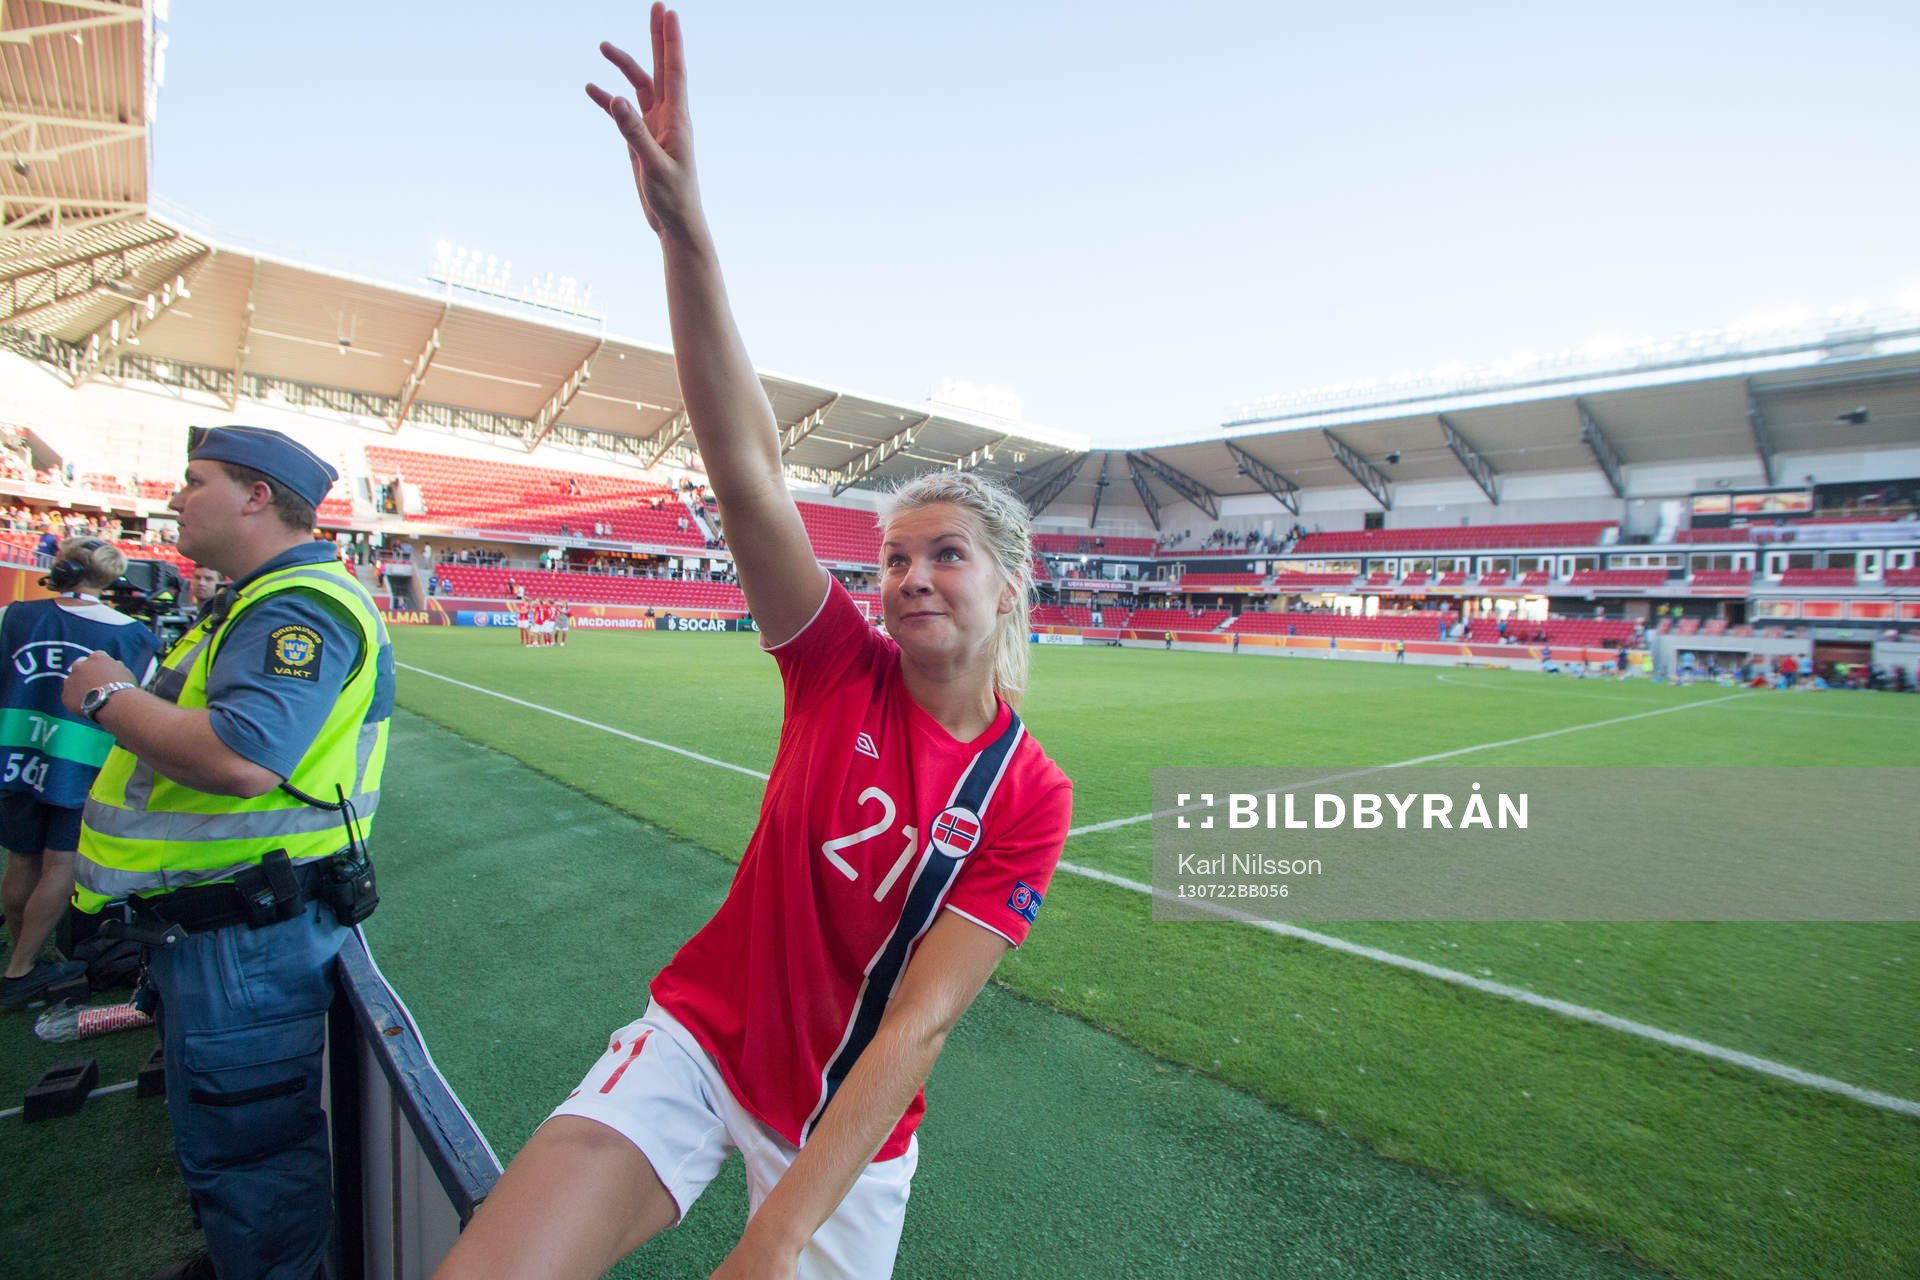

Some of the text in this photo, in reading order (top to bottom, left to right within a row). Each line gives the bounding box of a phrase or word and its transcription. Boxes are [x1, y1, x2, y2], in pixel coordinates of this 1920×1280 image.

[380, 611, 429, 624] ALMAR
[577, 617, 643, 628] McDonald's
[678, 618, 726, 632] SOCAR
[271, 625, 322, 644] ORDNINGS
[273, 666, 312, 678] VAKT
[28, 716, 59, 748] TV
[2, 753, 49, 793] 561
[821, 786, 918, 903] 21
